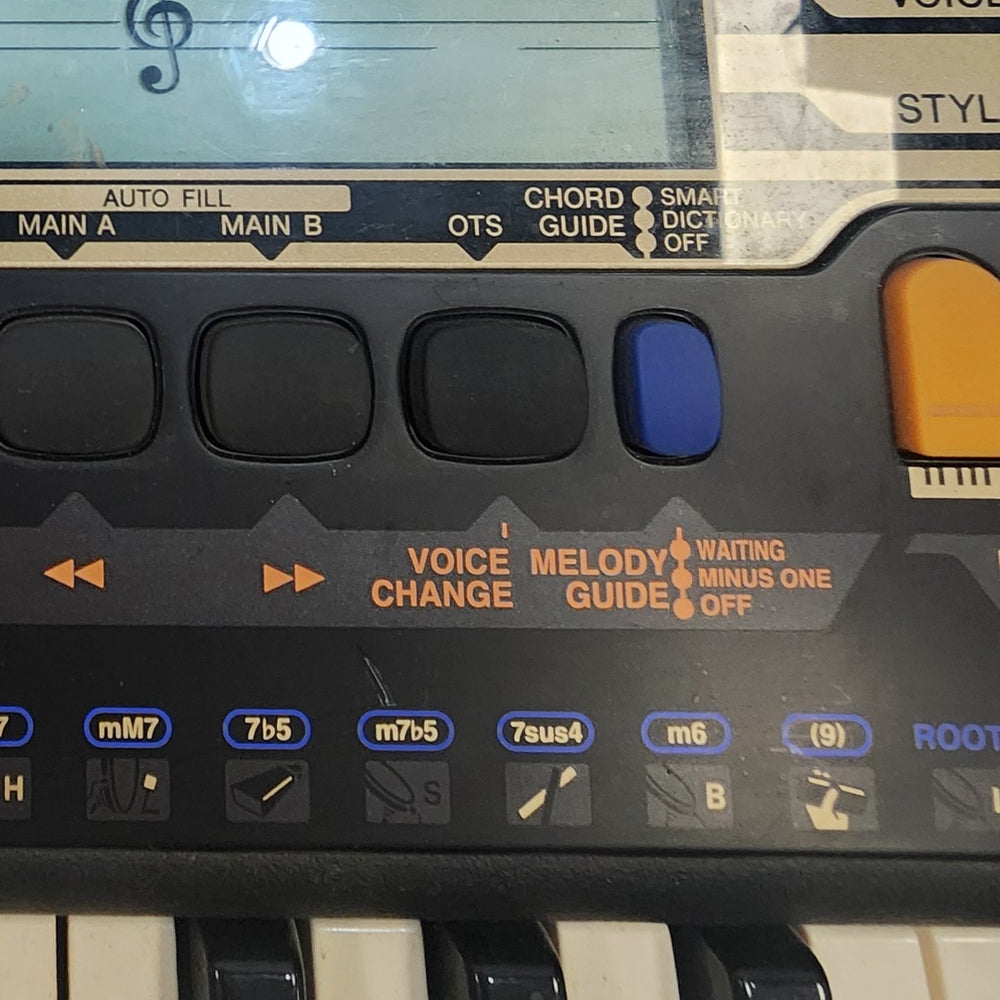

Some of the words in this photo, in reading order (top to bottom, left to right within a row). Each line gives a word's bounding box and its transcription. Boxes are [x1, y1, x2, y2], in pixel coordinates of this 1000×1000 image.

[103, 188, 170, 209] AUTO
[181, 188, 231, 209] FILL
[525, 187, 624, 208] CHORD
[660, 188, 742, 206] SMART
[19, 214, 86, 235] MAIN
[97, 214, 116, 235] A
[221, 215, 290, 235] MAIN
[304, 215, 322, 235] B
[449, 215, 503, 236] OTS
[539, 215, 626, 236] GUIDE
[663, 211, 807, 229] DICTIONARY
[665, 233, 709, 252] OFF
[696, 539, 785, 561] WAITING
[408, 548, 510, 575] VOICE
[531, 549, 668, 576] MELODY
[699, 568, 774, 588] MINUS
[780, 568, 832, 588] ONE
[372, 580, 513, 607] CHANGE
[566, 581, 669, 609] GUIDE
[701, 594, 751, 616] OFF
[99, 717, 159, 739] mM7
[511, 722, 583, 743] 7sus4
[668, 722, 707, 744] m6
[811, 721, 848, 747] (9)
